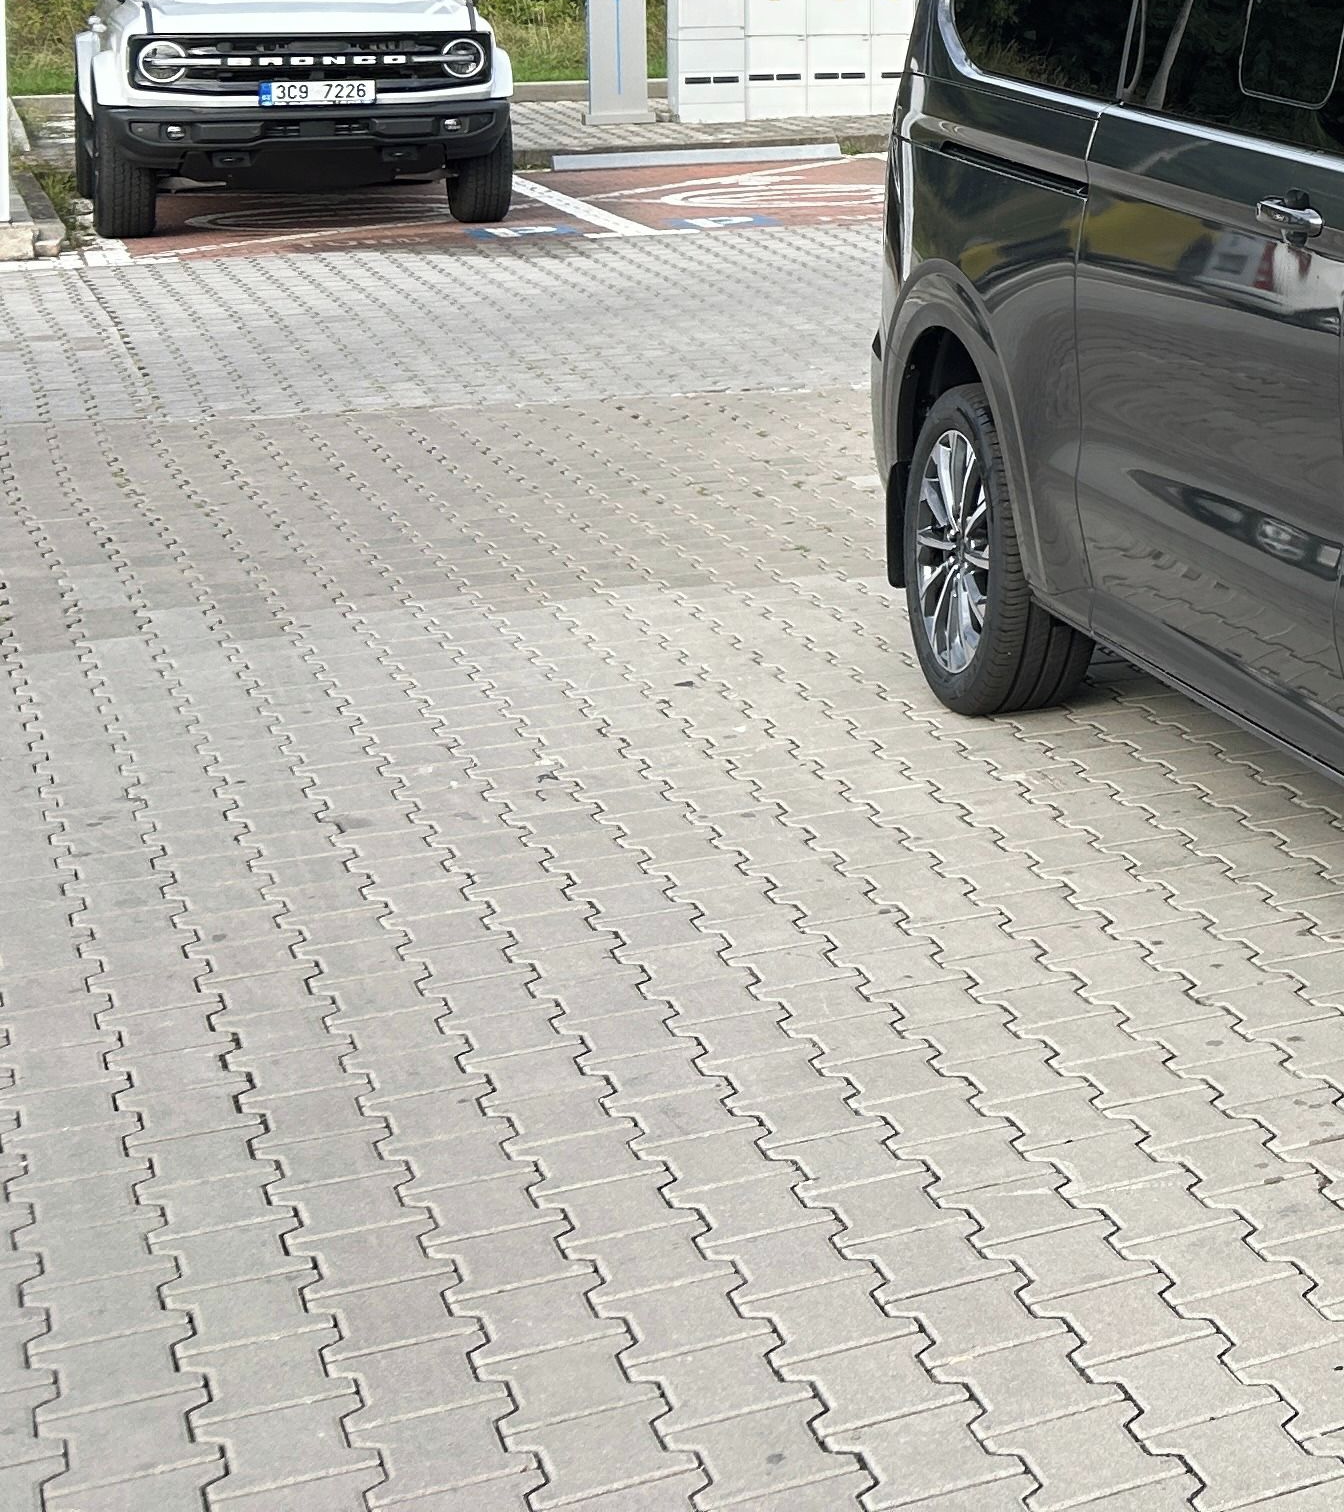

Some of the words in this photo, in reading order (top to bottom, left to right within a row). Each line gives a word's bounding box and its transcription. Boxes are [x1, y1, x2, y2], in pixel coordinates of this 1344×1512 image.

[227, 55, 407, 66] BRONCO
[276, 84, 309, 99] 3C9
[322, 83, 367, 99] 7226
